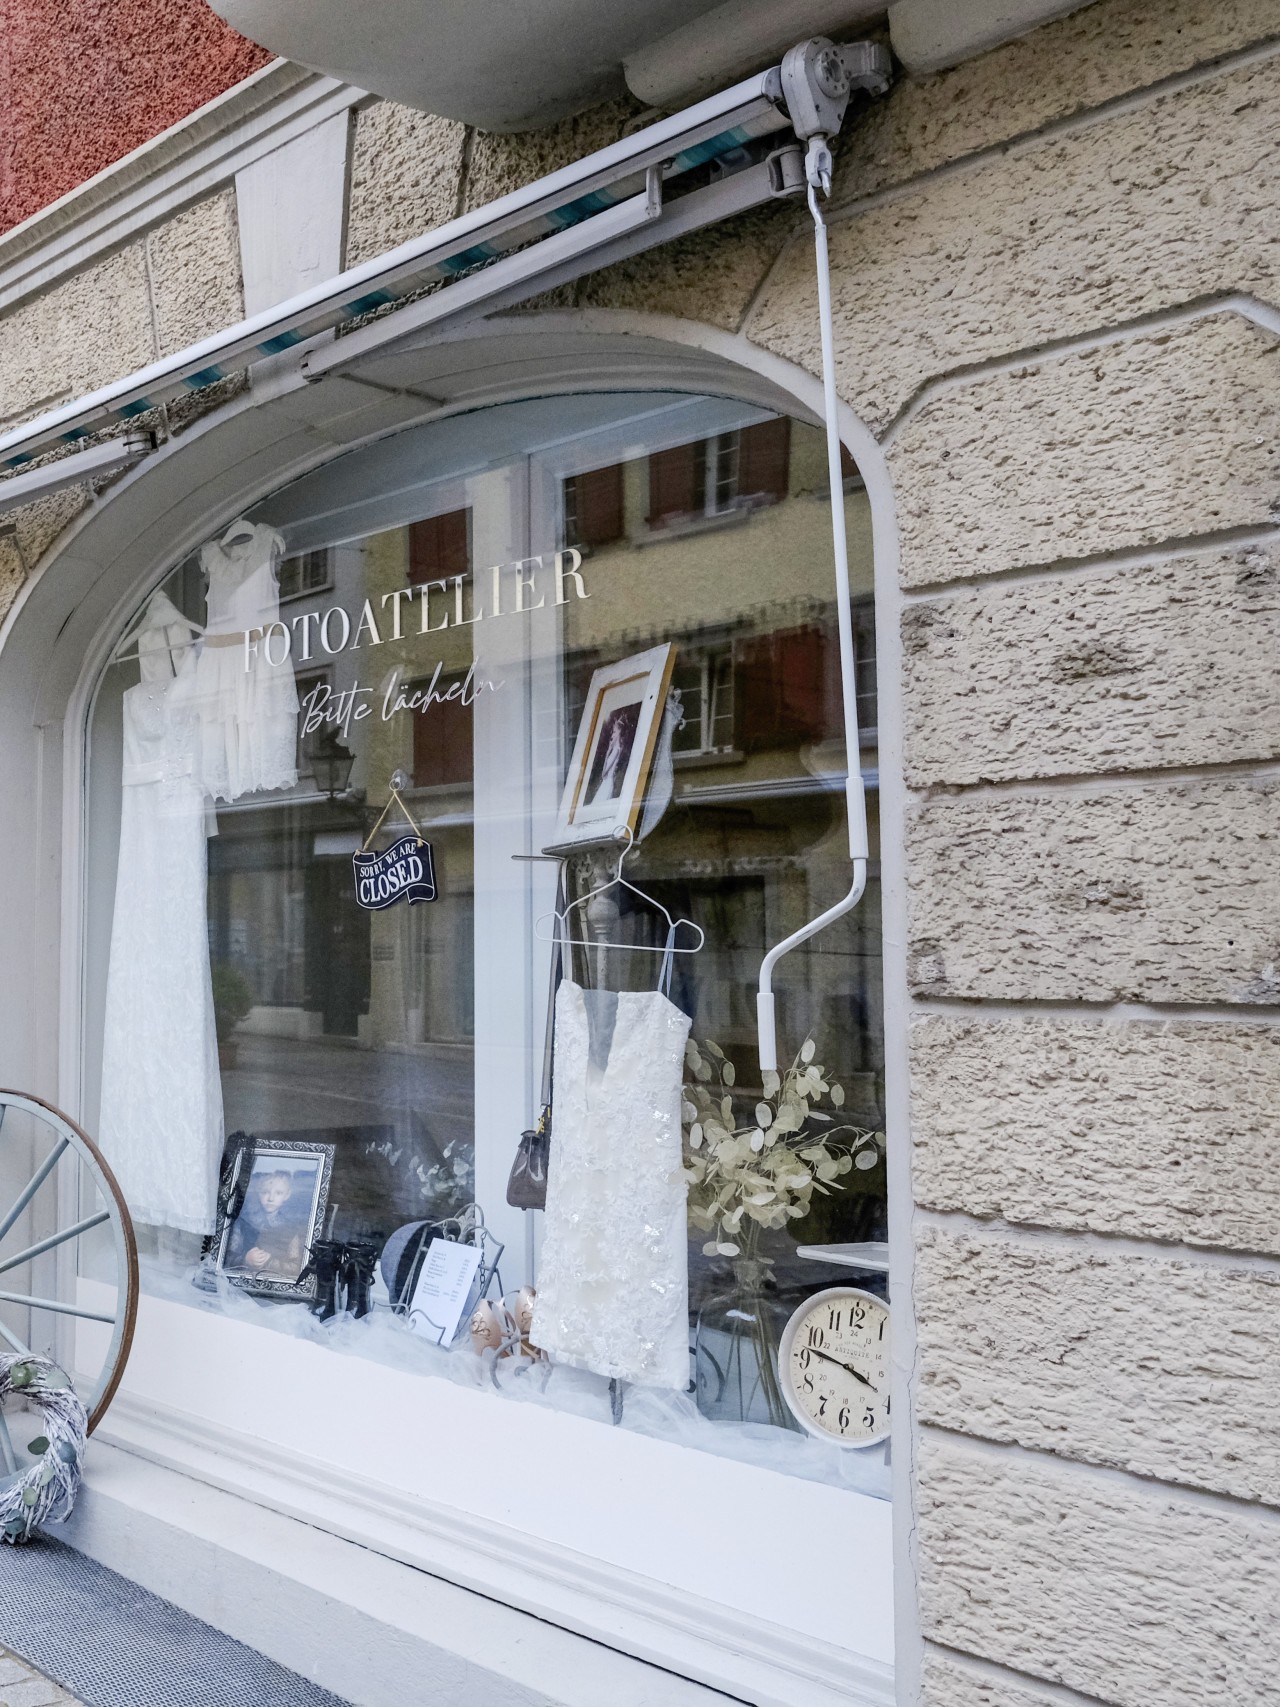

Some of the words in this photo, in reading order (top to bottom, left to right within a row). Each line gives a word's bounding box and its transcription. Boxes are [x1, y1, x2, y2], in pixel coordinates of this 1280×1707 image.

[242, 548, 592, 673] FOTOATELIER
[300, 680, 373, 738] Bitte
[382, 655, 506, 721] lächeln
[385, 851, 398, 864] WE
[400, 842, 416, 857] ARE
[360, 856, 423, 903] CLOSED
[829, 1309, 841, 1331] 11
[849, 1306, 865, 1330] 12
[807, 1326, 824, 1348] 10
[799, 1348, 811, 1370] 9
[802, 1372, 814, 1394] 8
[819, 1395, 828, 1417] 7
[862, 1406, 875, 1428] 5
[838, 1407, 851, 1428] 6
